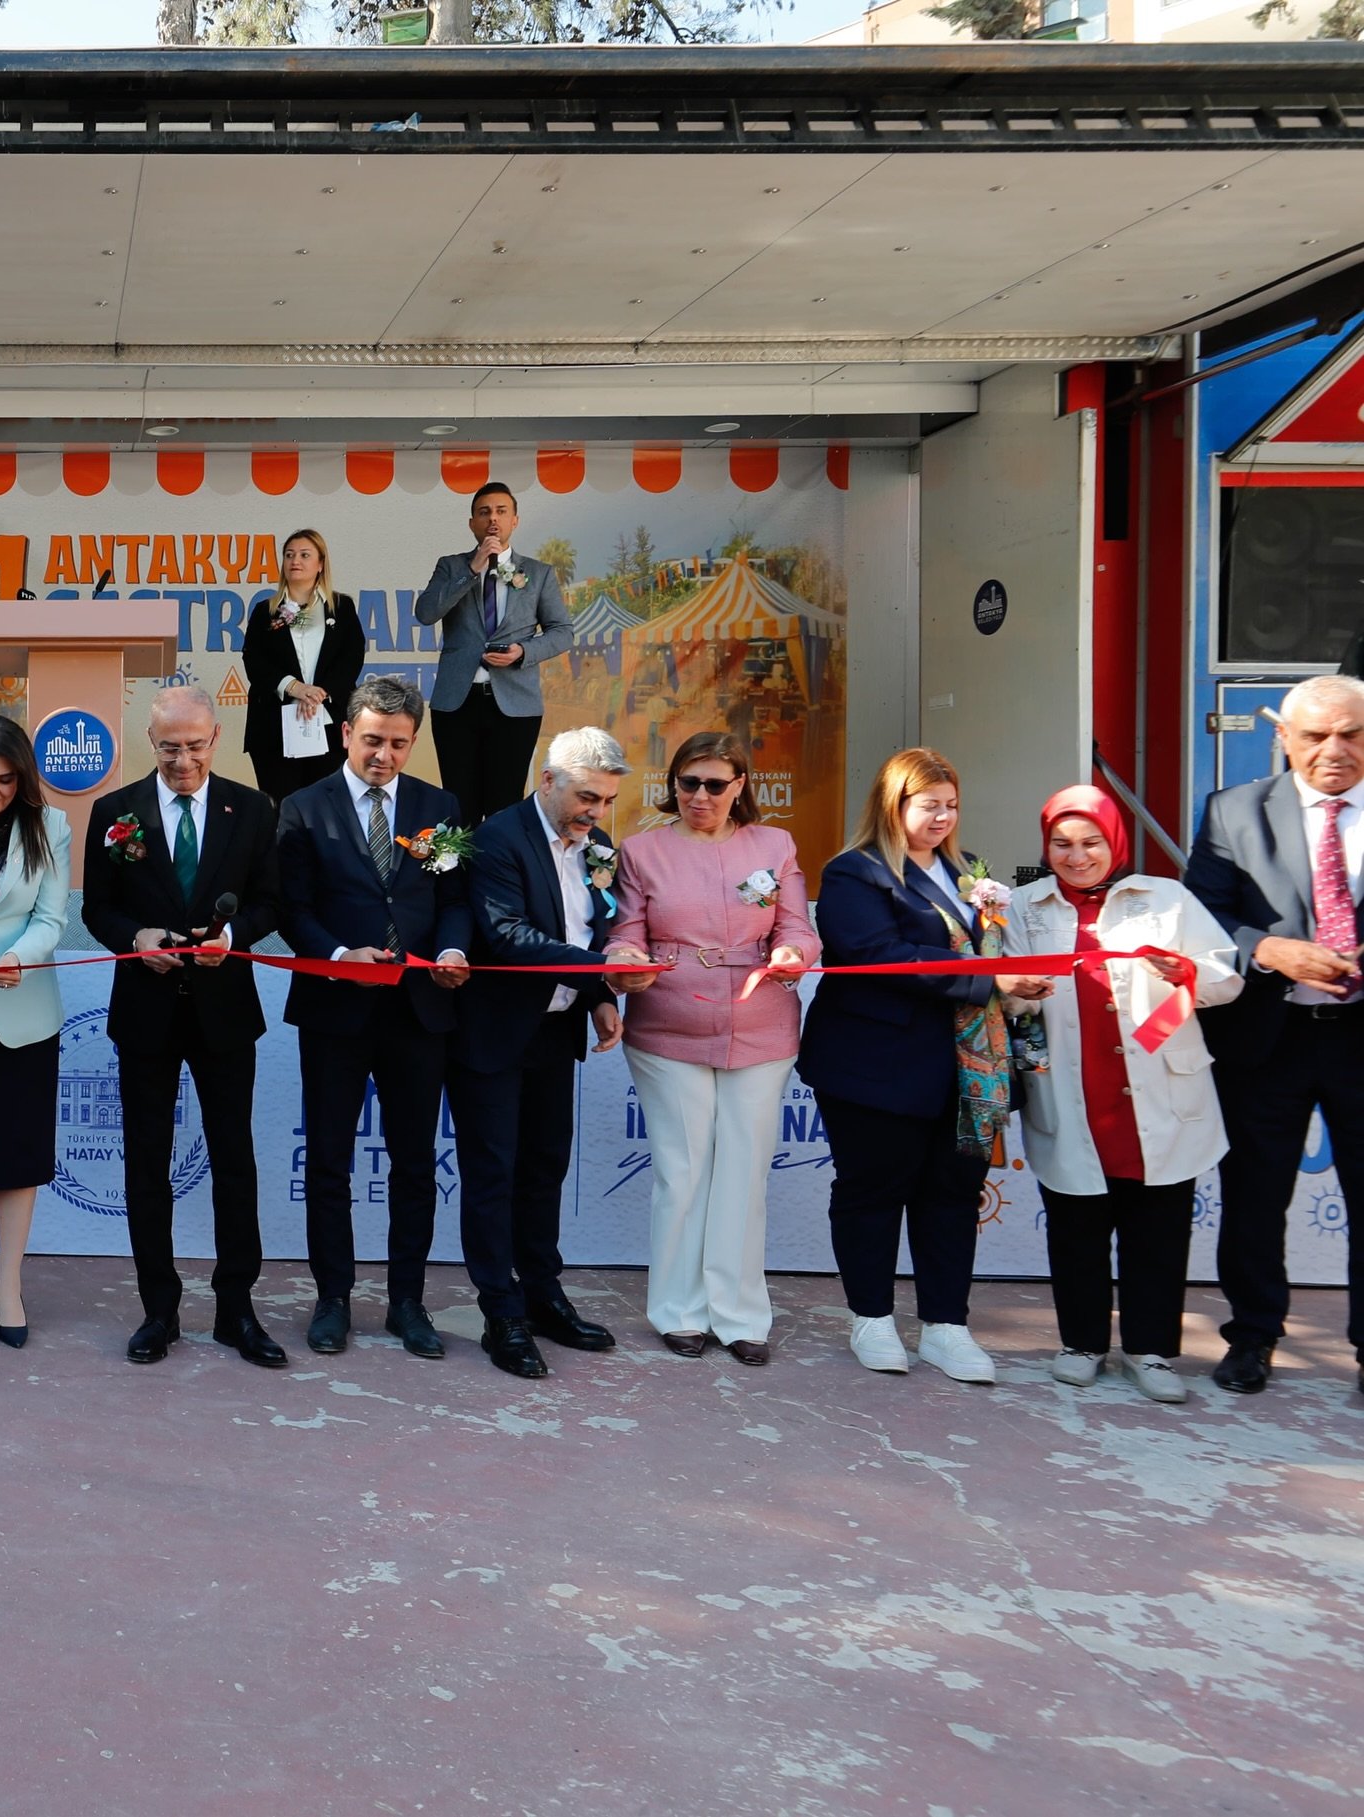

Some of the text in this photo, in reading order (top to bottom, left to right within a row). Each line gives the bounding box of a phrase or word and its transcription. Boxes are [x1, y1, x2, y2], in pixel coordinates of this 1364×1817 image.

[43, 534, 281, 584] ANTAKYA
[45, 755, 103, 765] ANTAKYA
[45, 763, 104, 772] BELEDİYESİ
[751, 772, 792, 782] AŞKANI
[67, 1135, 107, 1144] TÜRKİYE
[66, 1148, 114, 1161] HATAY
